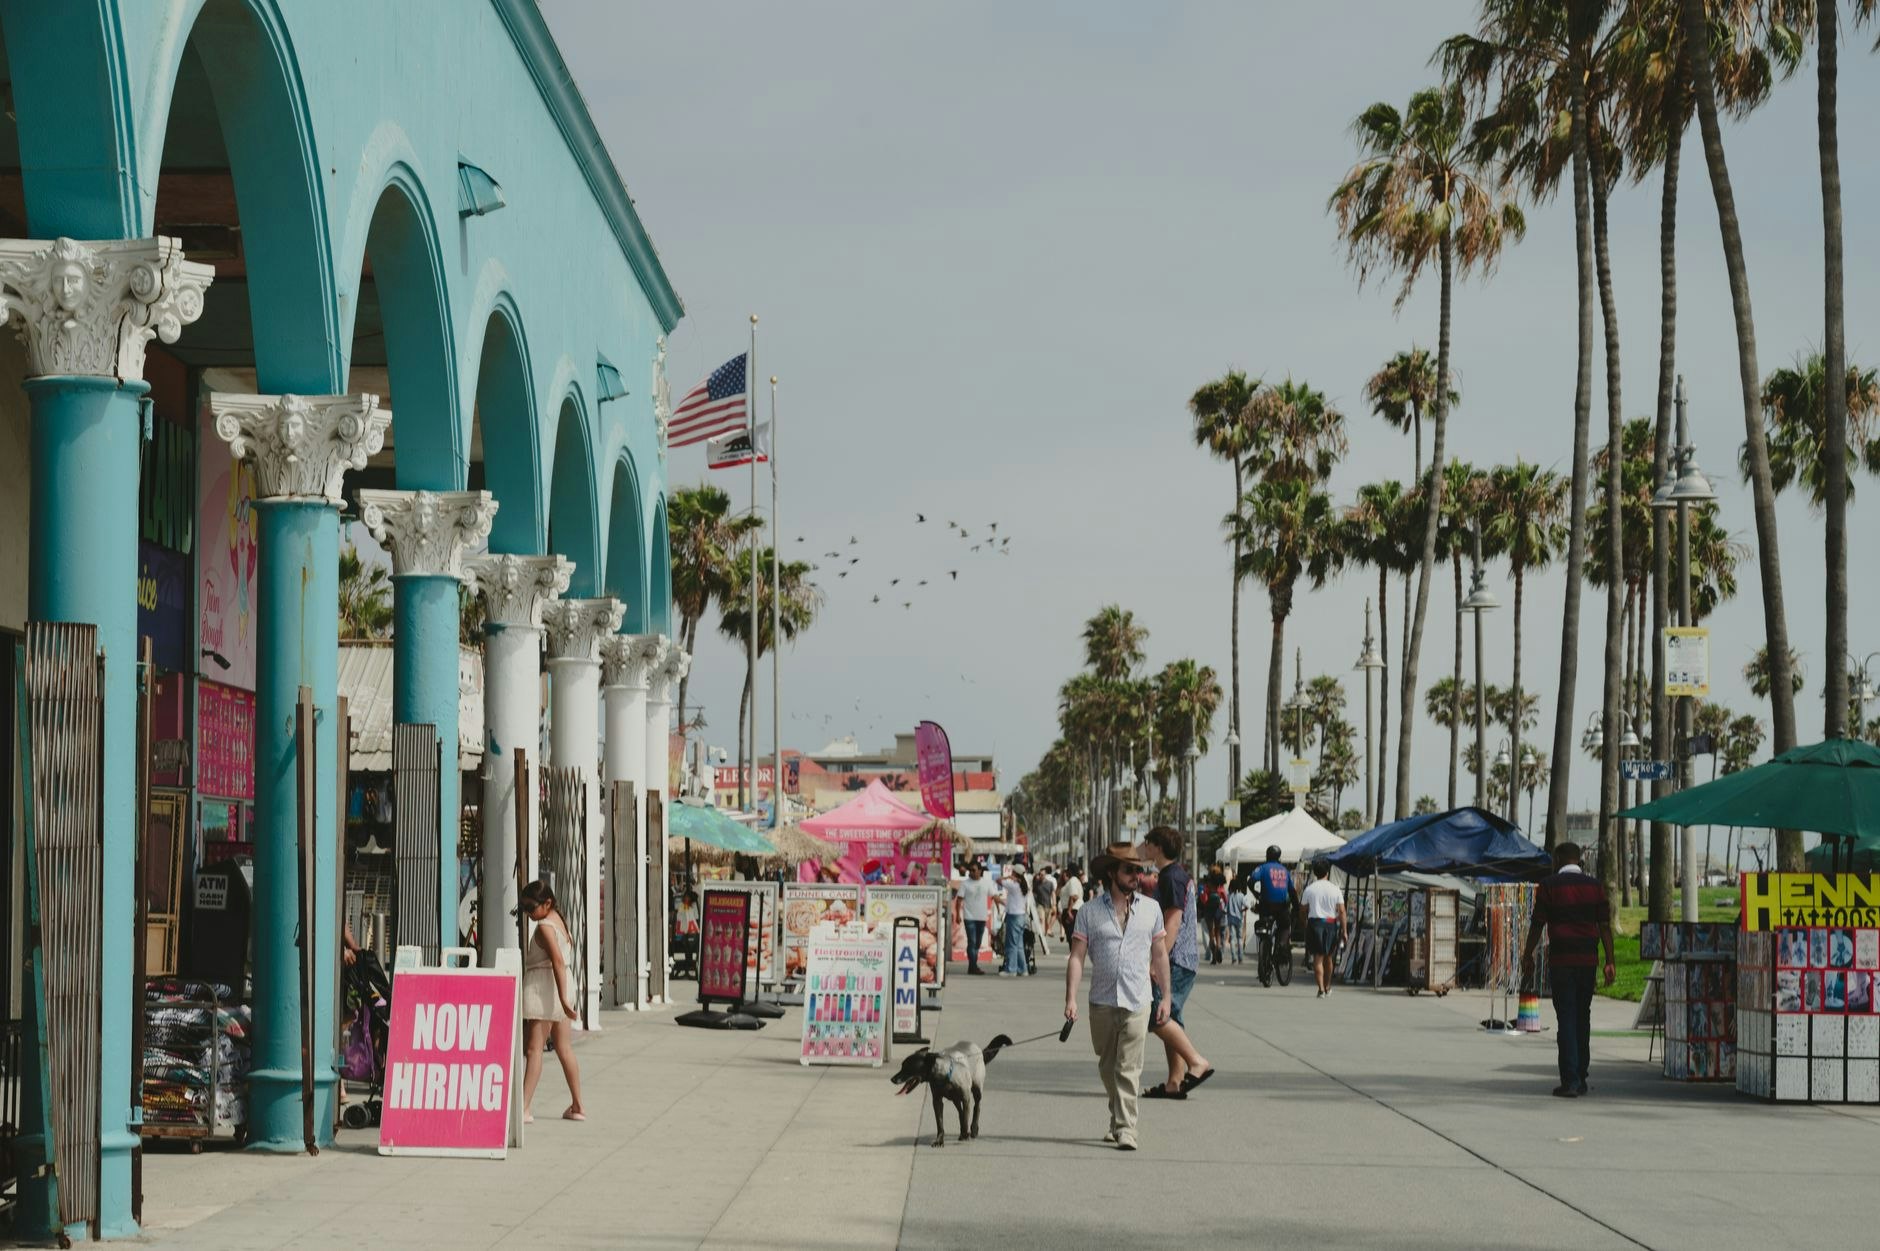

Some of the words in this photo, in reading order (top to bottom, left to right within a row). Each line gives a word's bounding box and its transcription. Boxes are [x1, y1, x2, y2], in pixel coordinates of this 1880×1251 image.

[198, 878, 226, 890] ATM
[789, 890, 826, 898] FUNNEL
[829, 890, 854, 898] CAKE
[897, 945, 916, 1005] ATM
[412, 1003, 492, 1051] NOW
[389, 1062, 504, 1111] HIRING
